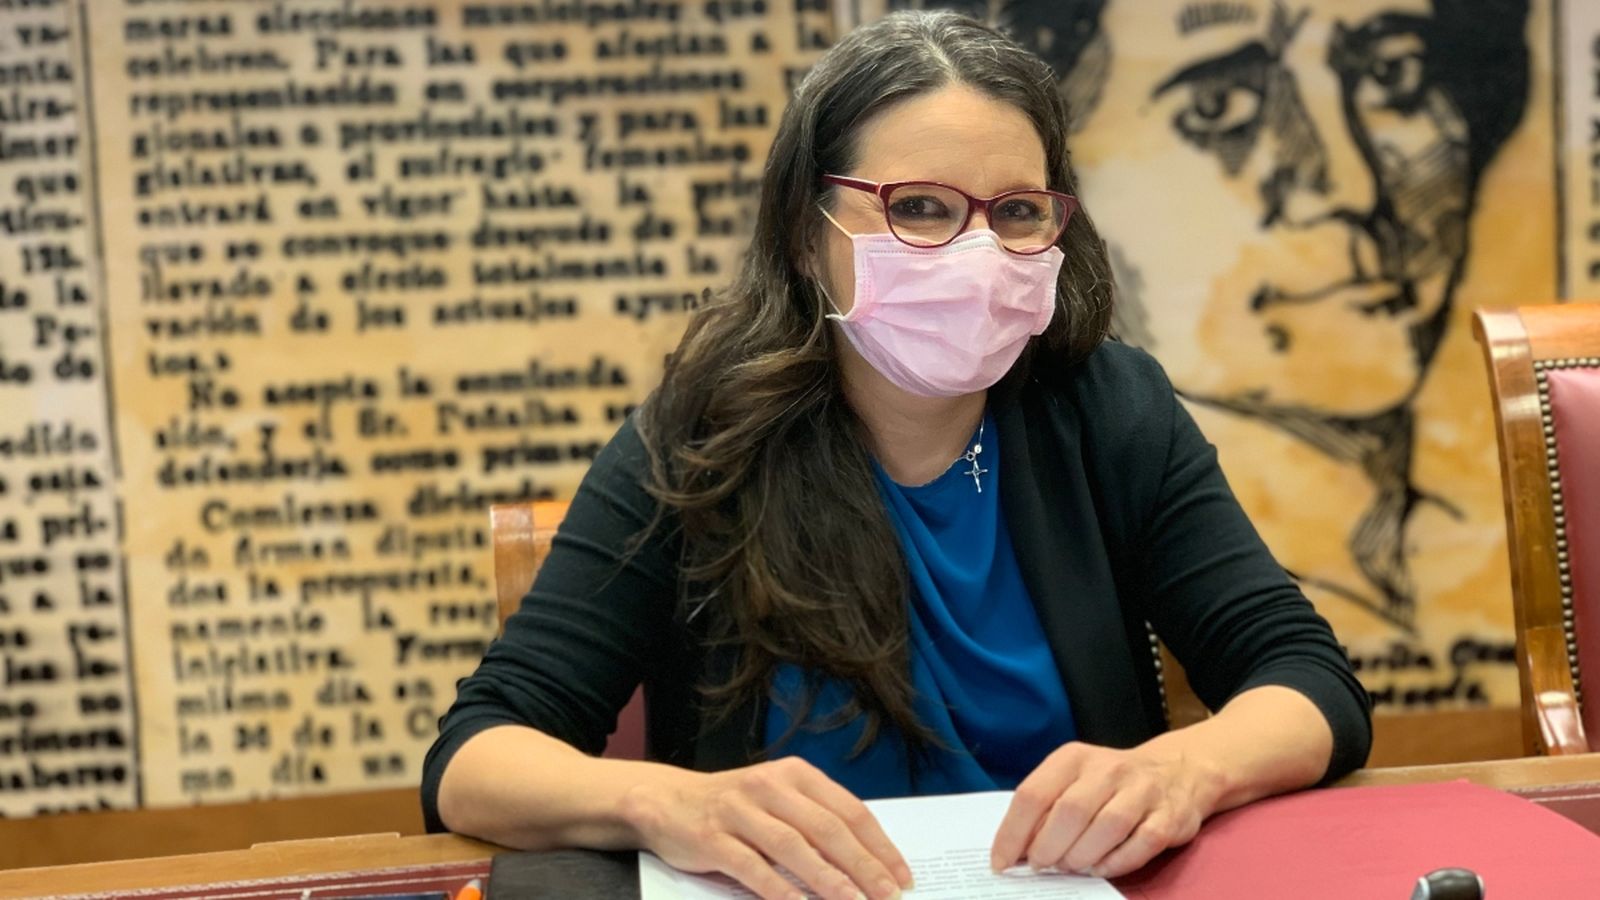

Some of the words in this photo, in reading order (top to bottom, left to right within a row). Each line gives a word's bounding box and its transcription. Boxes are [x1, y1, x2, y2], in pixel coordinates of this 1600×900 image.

[314, 37, 403, 69] Para
[426, 36, 477, 65] las
[505, 42, 567, 68] que
[750, 31, 771, 51] a
[425, 81, 465, 101] en
[300, 124, 320, 146] o
[579, 113, 598, 143] y
[617, 110, 697, 139] para
[719, 98, 769, 129] las
[346, 154, 376, 181] el
[16, 174, 78, 203] que
[298, 199, 340, 221] en
[482, 185, 578, 209] hasta
[618, 176, 650, 207] la
[139, 243, 204, 269] que
[226, 240, 261, 260] se
[633, 214, 677, 240] de
[142, 264, 272, 302] llevado
[297, 275, 317, 295] a
[341, 261, 448, 293] efecto
[687, 245, 719, 275] la
[55, 275, 88, 306] la
[290, 302, 330, 332] de
[357, 304, 406, 331] los
[54, 350, 94, 382] de
[190, 378, 240, 410] No
[397, 367, 431, 397] la
[260, 422, 277, 454] y
[0, 554, 49, 585] ue
[33, 590, 58, 614] a
[80, 578, 114, 611] la
[249, 571, 281, 601] la
[361, 594, 394, 632] la
[395, 679, 434, 700] en
[179, 724, 212, 754] la
[294, 714, 333, 747] de
[352, 712, 384, 743] la
[361, 753, 405, 777] un
